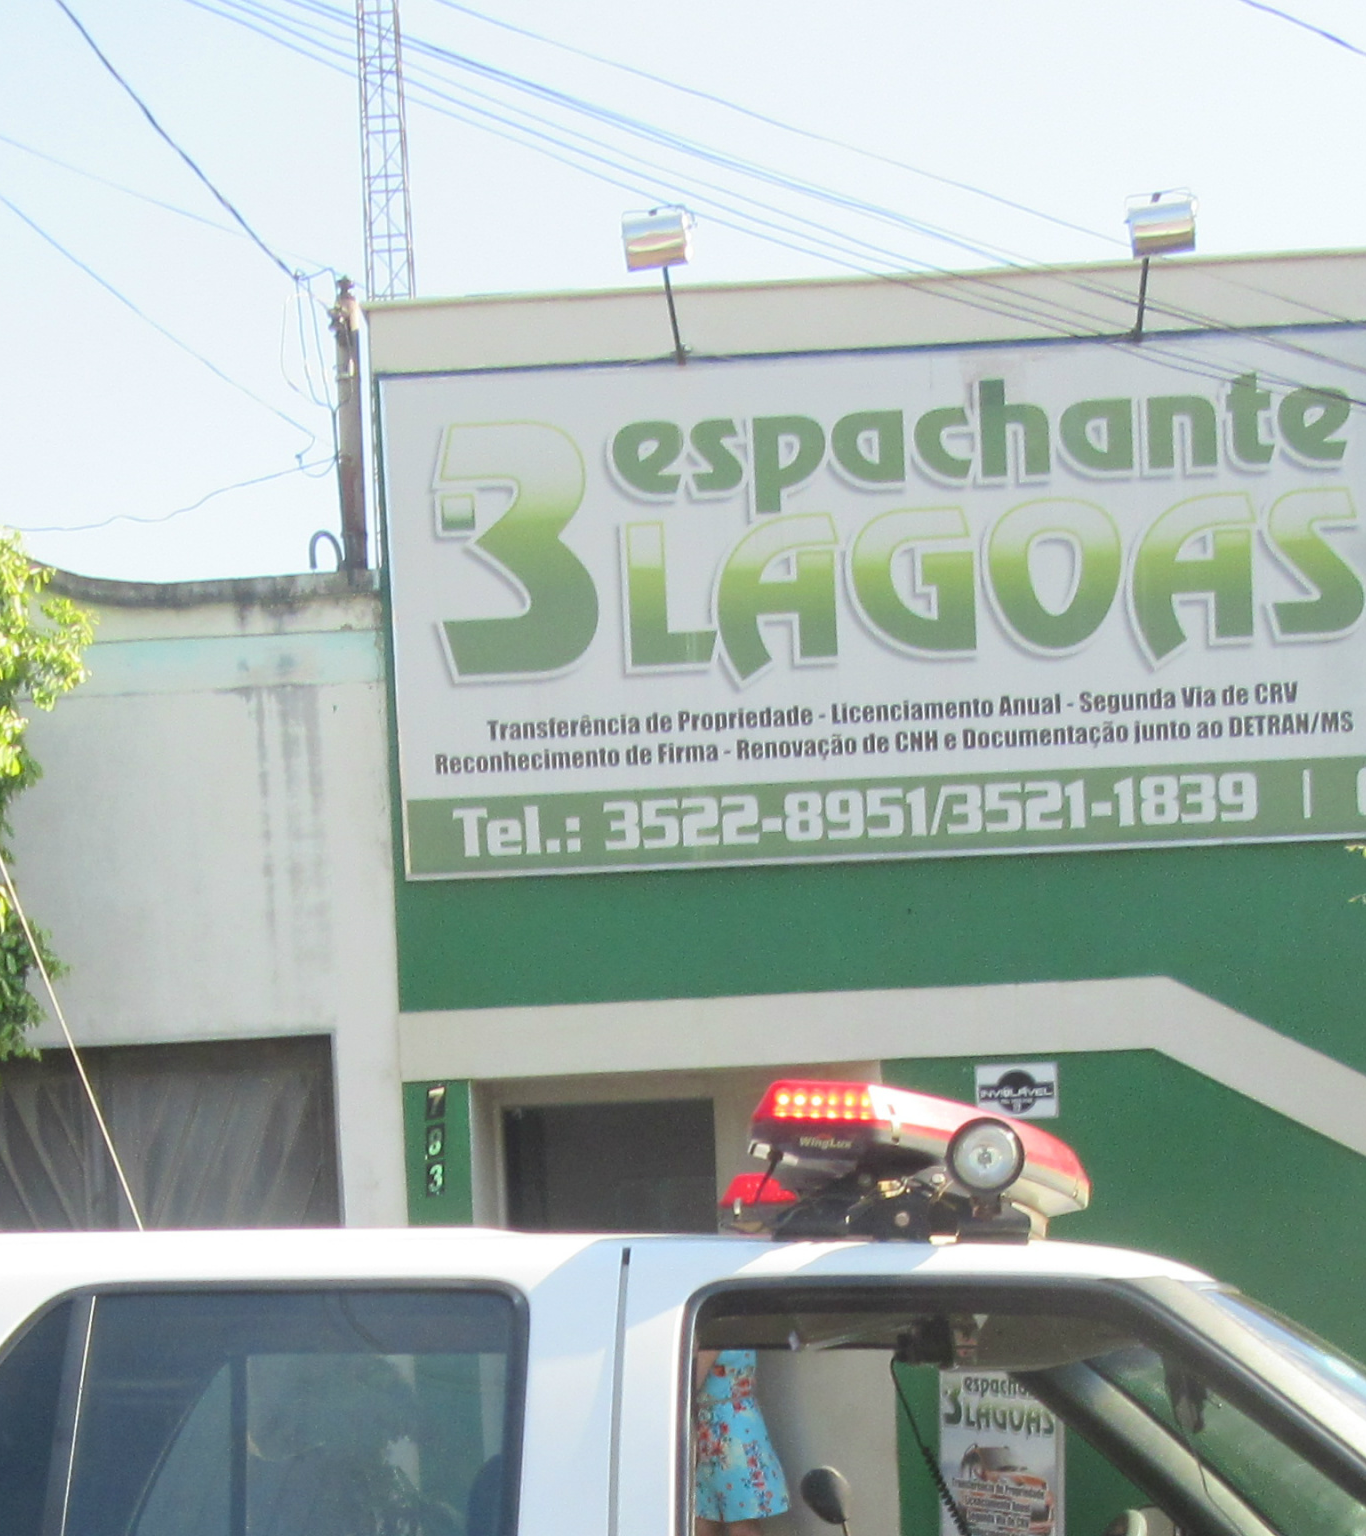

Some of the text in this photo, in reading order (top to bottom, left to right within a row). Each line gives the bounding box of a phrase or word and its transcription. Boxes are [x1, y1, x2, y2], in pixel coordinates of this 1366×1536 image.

[613, 373, 1352, 514] espachante
[435, 420, 1365, 684] 3 LAGOAS
[434, 710, 1354, 775] Reconhecimento de Firma Renovação de CNH e Documentação junto ao DETRAN/MS
[487, 681, 1298, 741] Transferência de Propriedade Licenciamento Anual Segunda Via de CRV
[452, 804, 582, 858] Tel.:
[603, 772, 1258, 850] 3522-8951/3521-1839
